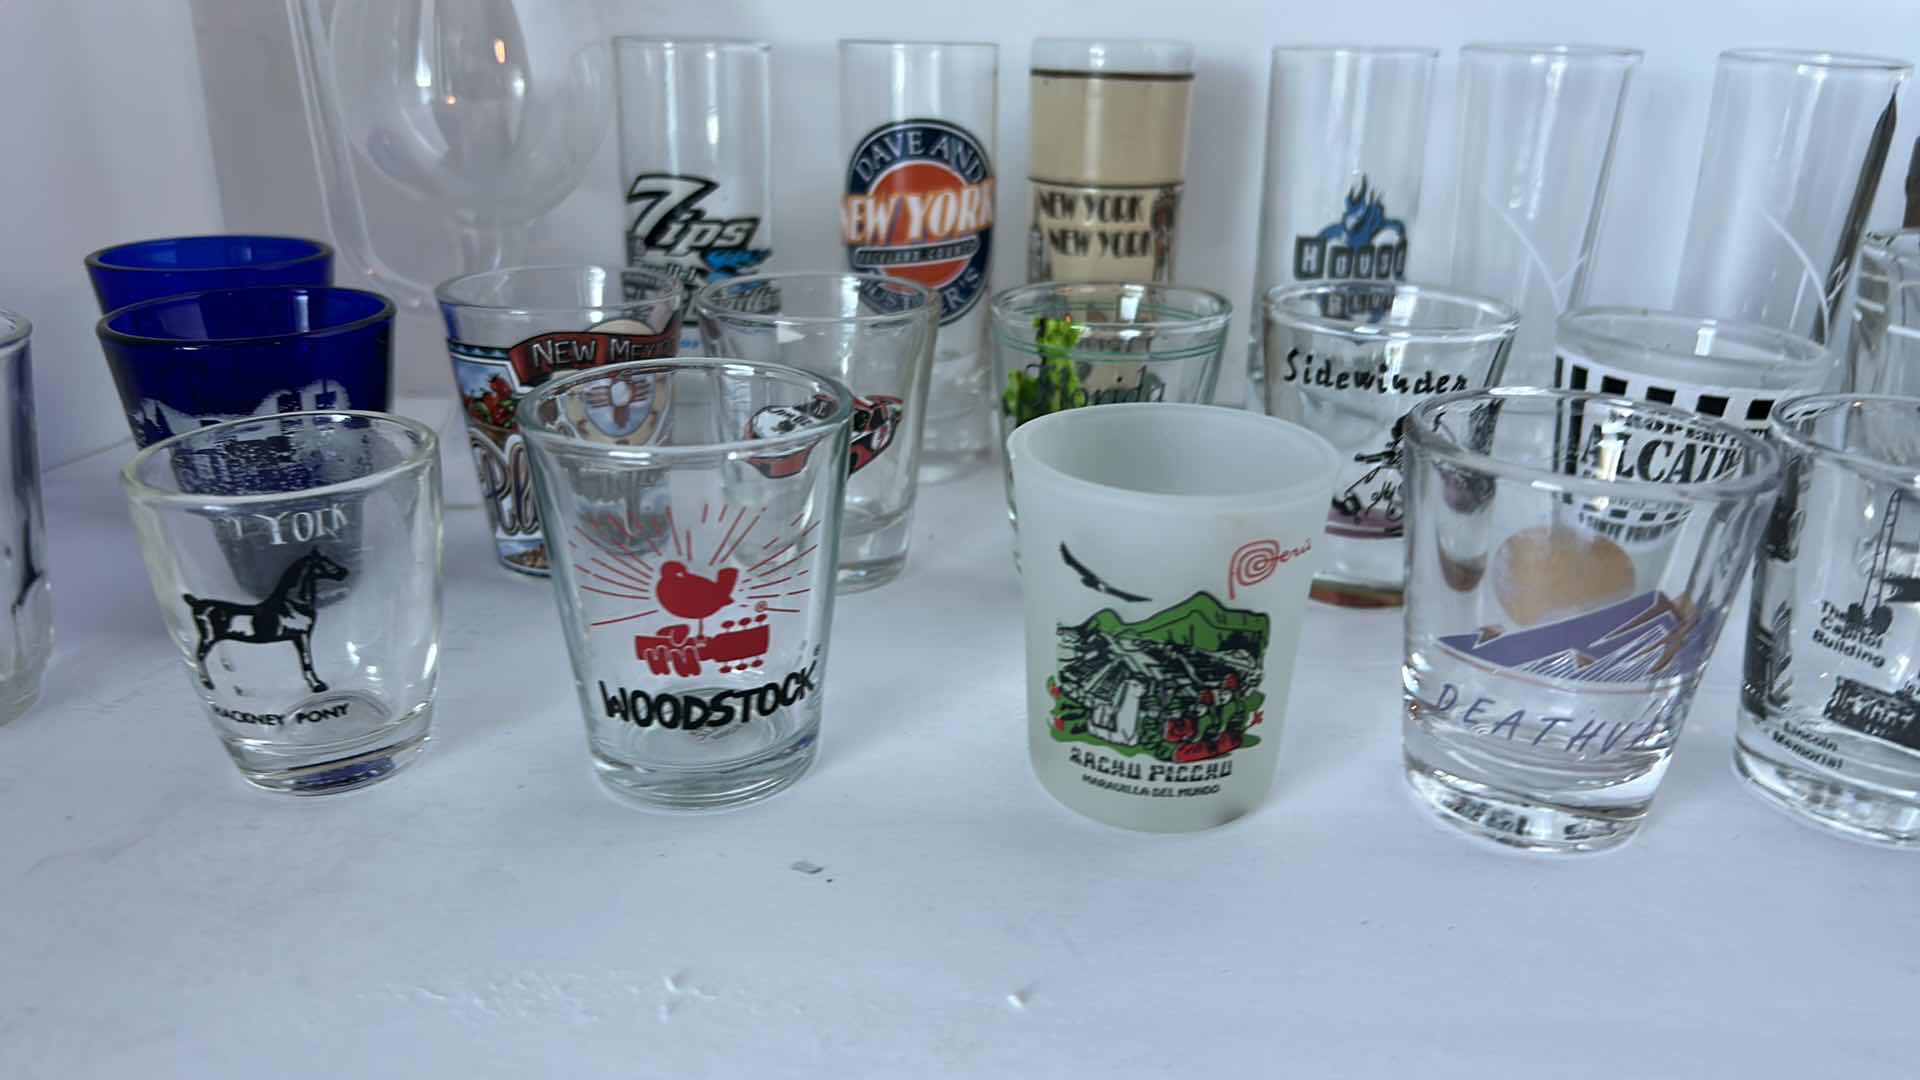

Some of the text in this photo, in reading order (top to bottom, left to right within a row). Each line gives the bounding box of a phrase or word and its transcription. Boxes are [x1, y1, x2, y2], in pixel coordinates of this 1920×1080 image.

[856, 130, 985, 184] DAVE AND
[532, 339, 596, 368] NEW
[1283, 347, 1468, 395] Sidewinder
[1812, 628, 1886, 669] Building
[295, 702, 350, 725] PONY
[598, 659, 816, 731] WOODSTOCK
